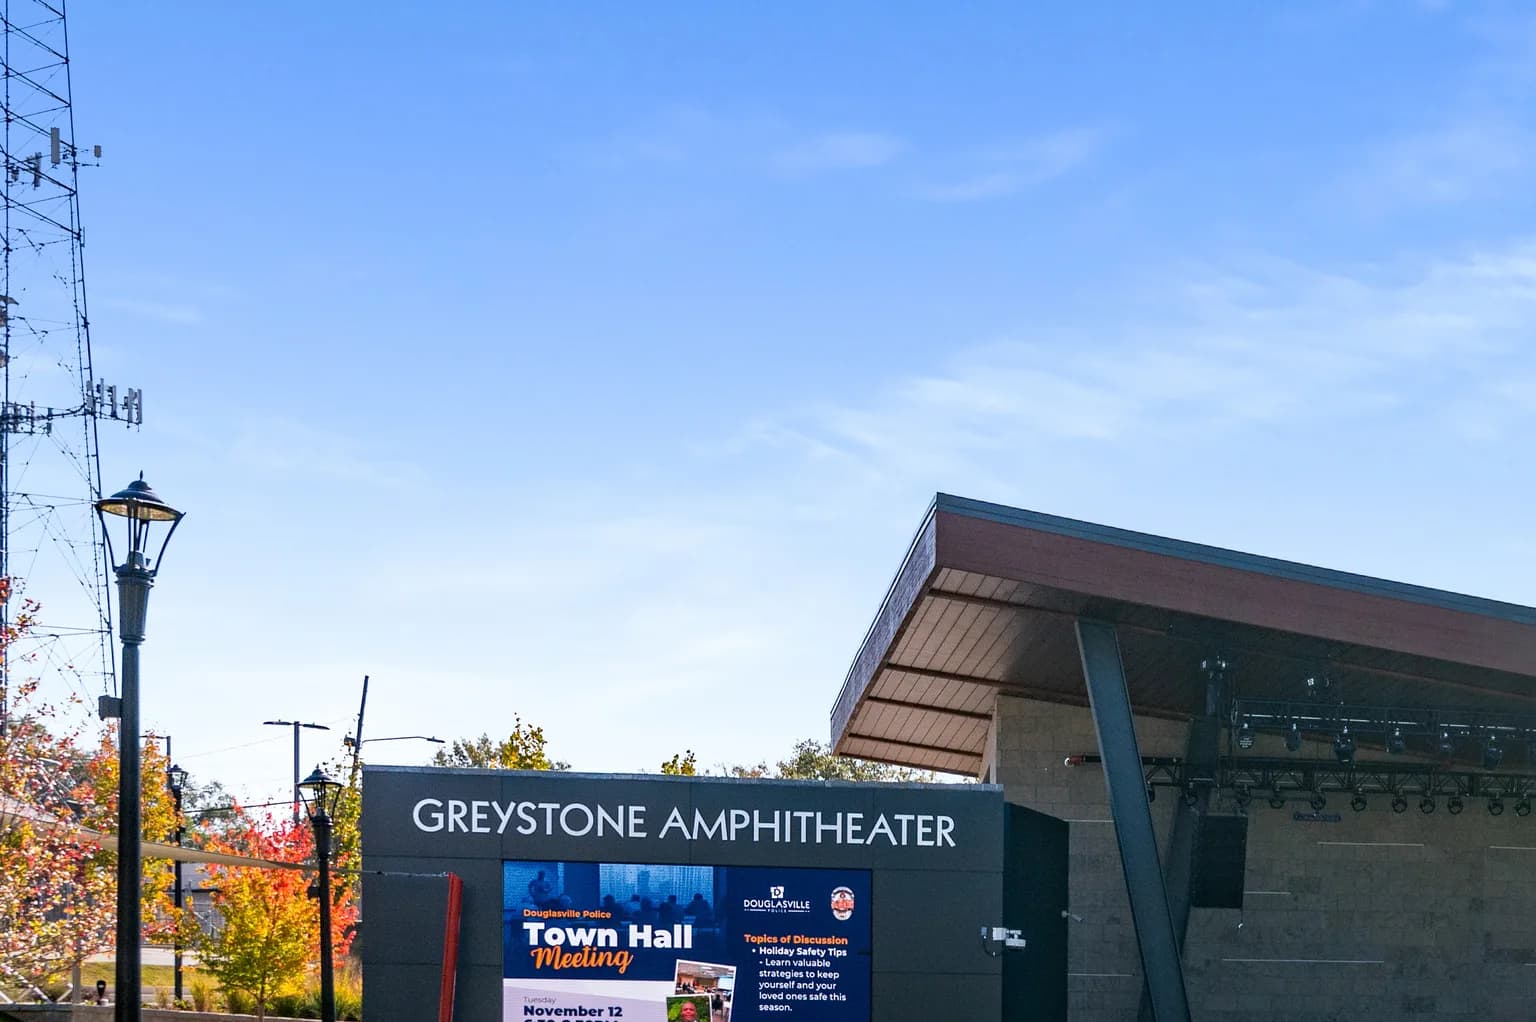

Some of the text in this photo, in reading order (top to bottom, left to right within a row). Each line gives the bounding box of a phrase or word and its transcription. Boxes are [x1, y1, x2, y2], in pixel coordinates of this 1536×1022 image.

[412, 799, 956, 849] GREYSTONE AMPHITHEATER
[744, 899, 810, 909] DOUGLASVILLE
[523, 909, 612, 919] Douglasville Police
[523, 922, 693, 949] Town Hall
[744, 934, 848, 945] Topics of Discussion
[759, 946, 847, 958] Holiday Safety Tips
[530, 945, 634, 974] Meeting
[765, 958, 831, 967] Learn valuable
[759, 970, 804, 979] strategies
[817, 970, 840, 980] keep
[759, 981, 795, 990] yourself
[815, 983, 837, 991] your
[523, 996, 557, 1004] Tuesday
[759, 992, 784, 1000] loved
[809, 993, 828, 1001] safe
[829, 993, 847, 1001] this
[523, 1005, 623, 1017] November 12
[759, 1004, 793, 1012] season.
